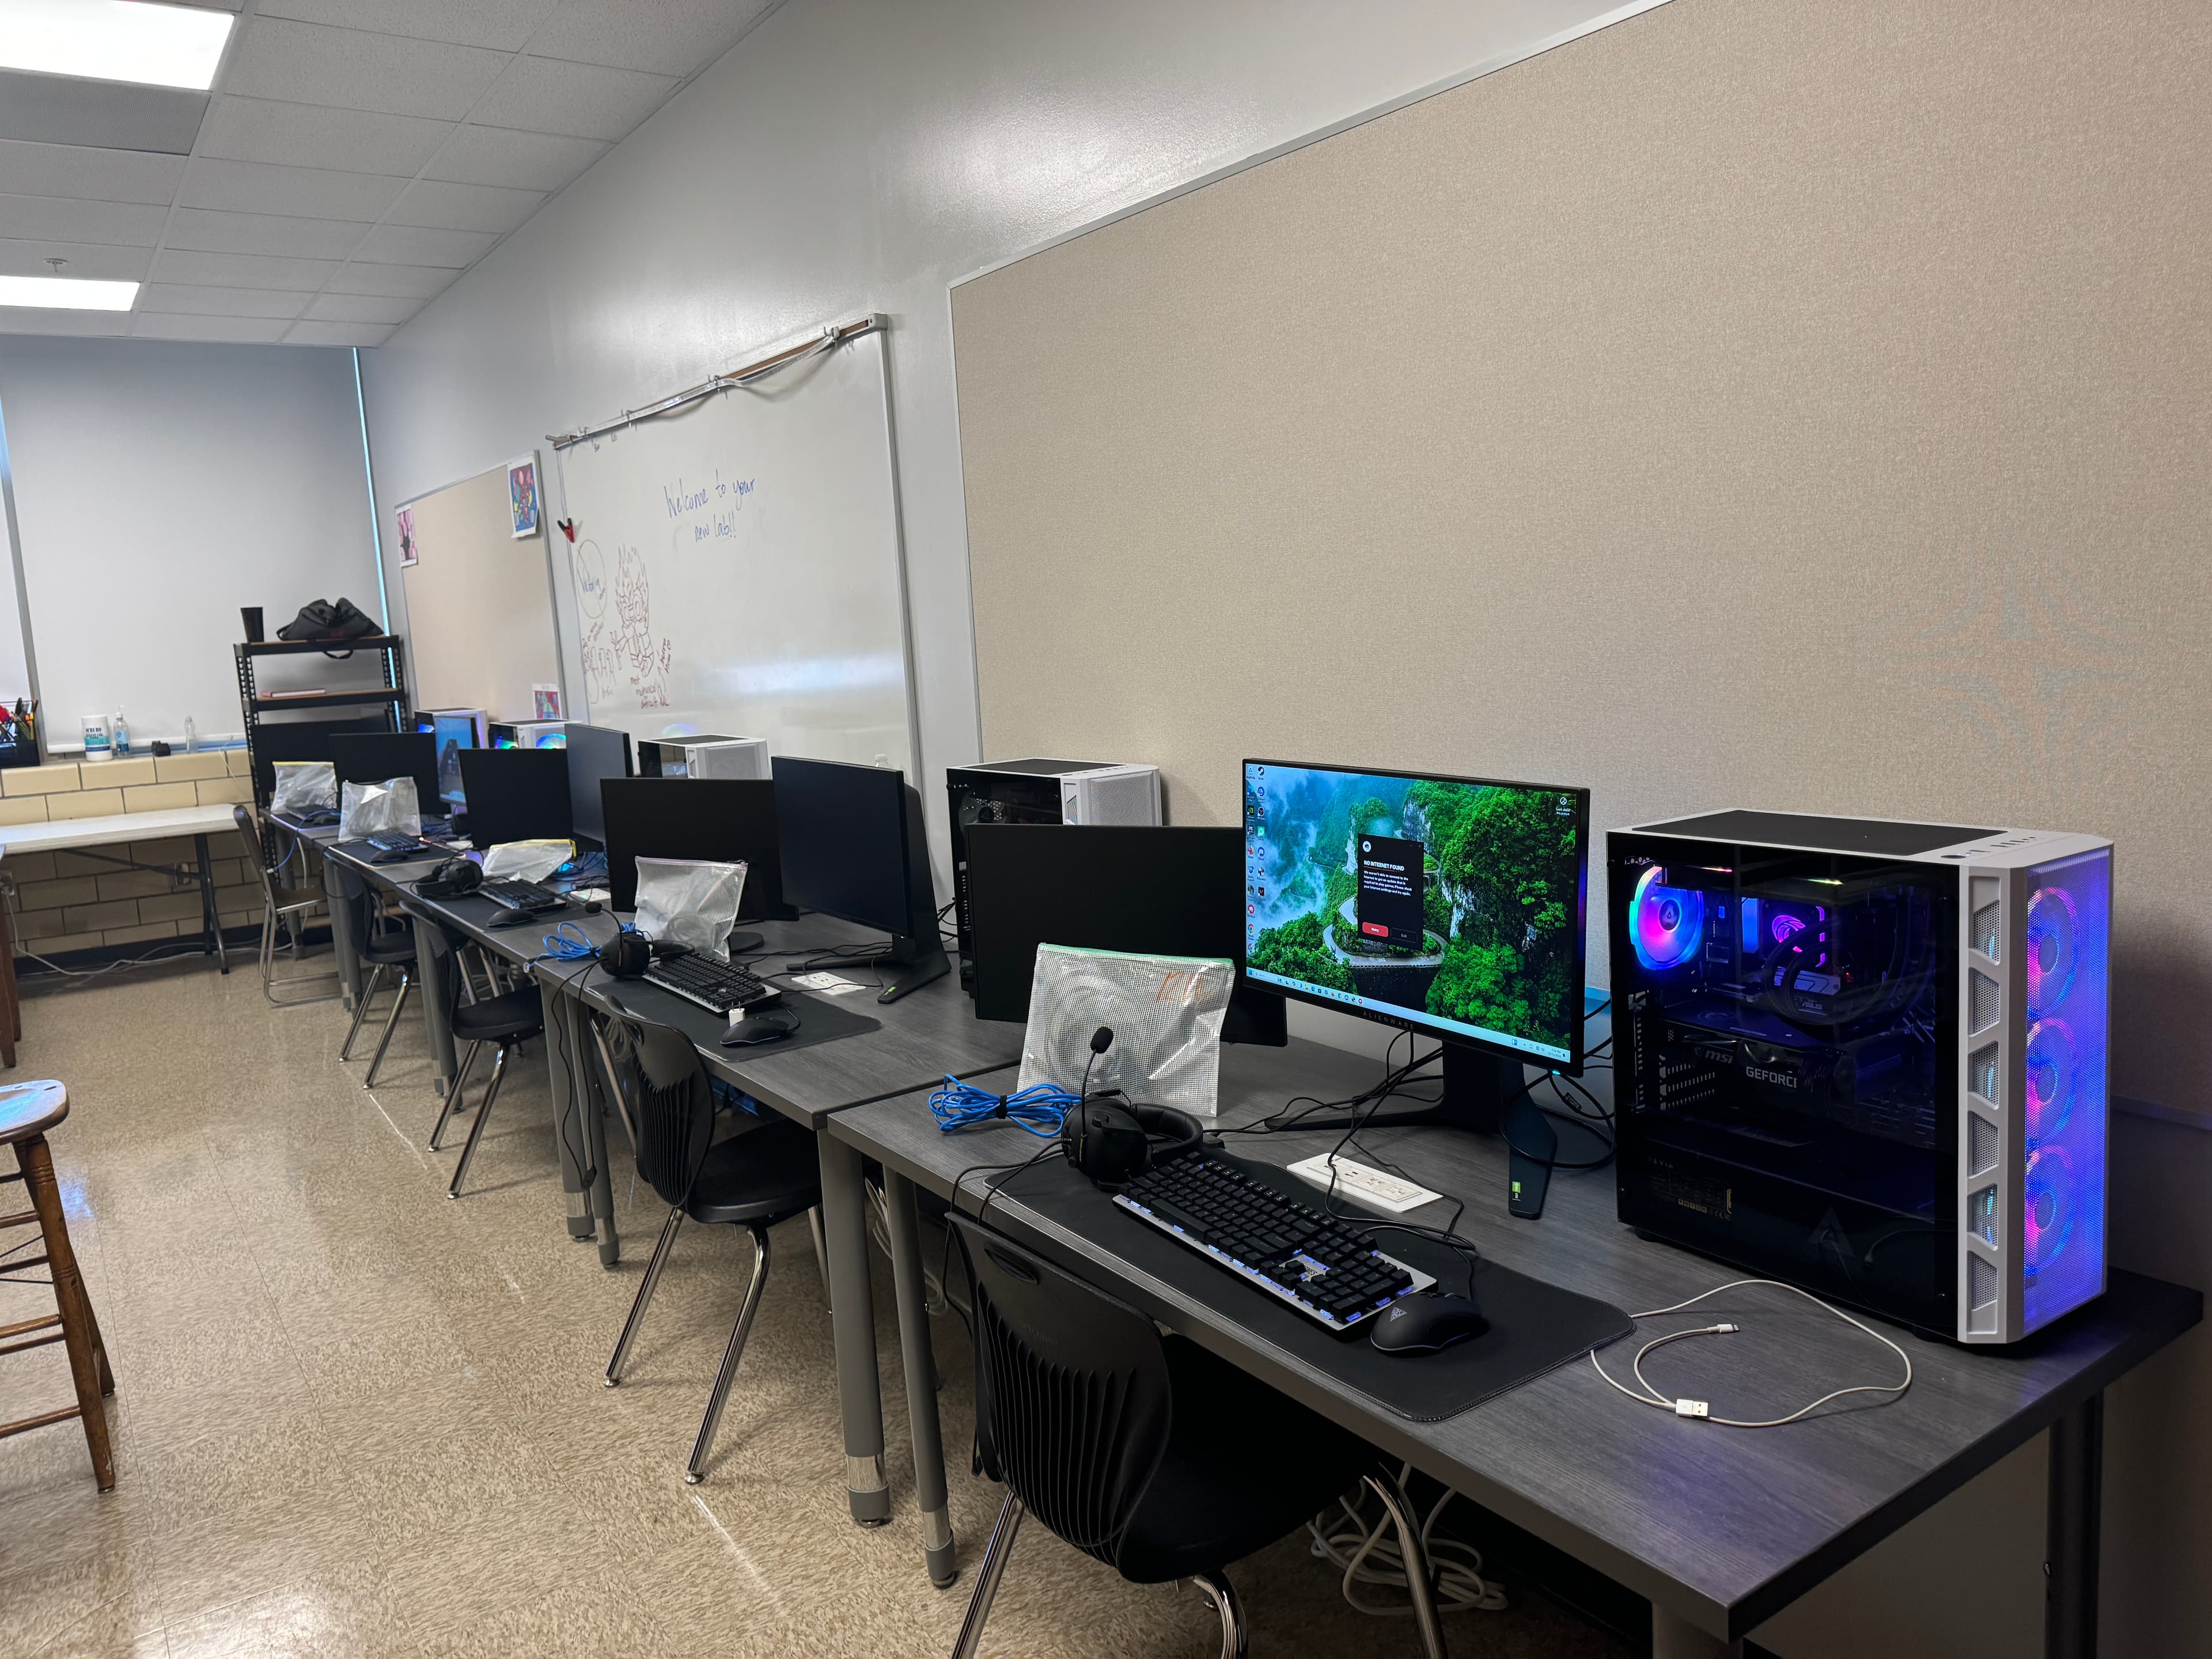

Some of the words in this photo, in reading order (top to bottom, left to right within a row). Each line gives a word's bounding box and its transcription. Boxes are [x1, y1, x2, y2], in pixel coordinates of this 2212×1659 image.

[664, 478, 709, 518] Welcome
[715, 469, 726, 498] to
[733, 479, 755, 511] your
[695, 523, 709, 542] new
[713, 511, 736, 539] lab!!
[1363, 1010, 1414, 1029] ALIENWARE
[1705, 1050, 1733, 1064] msi
